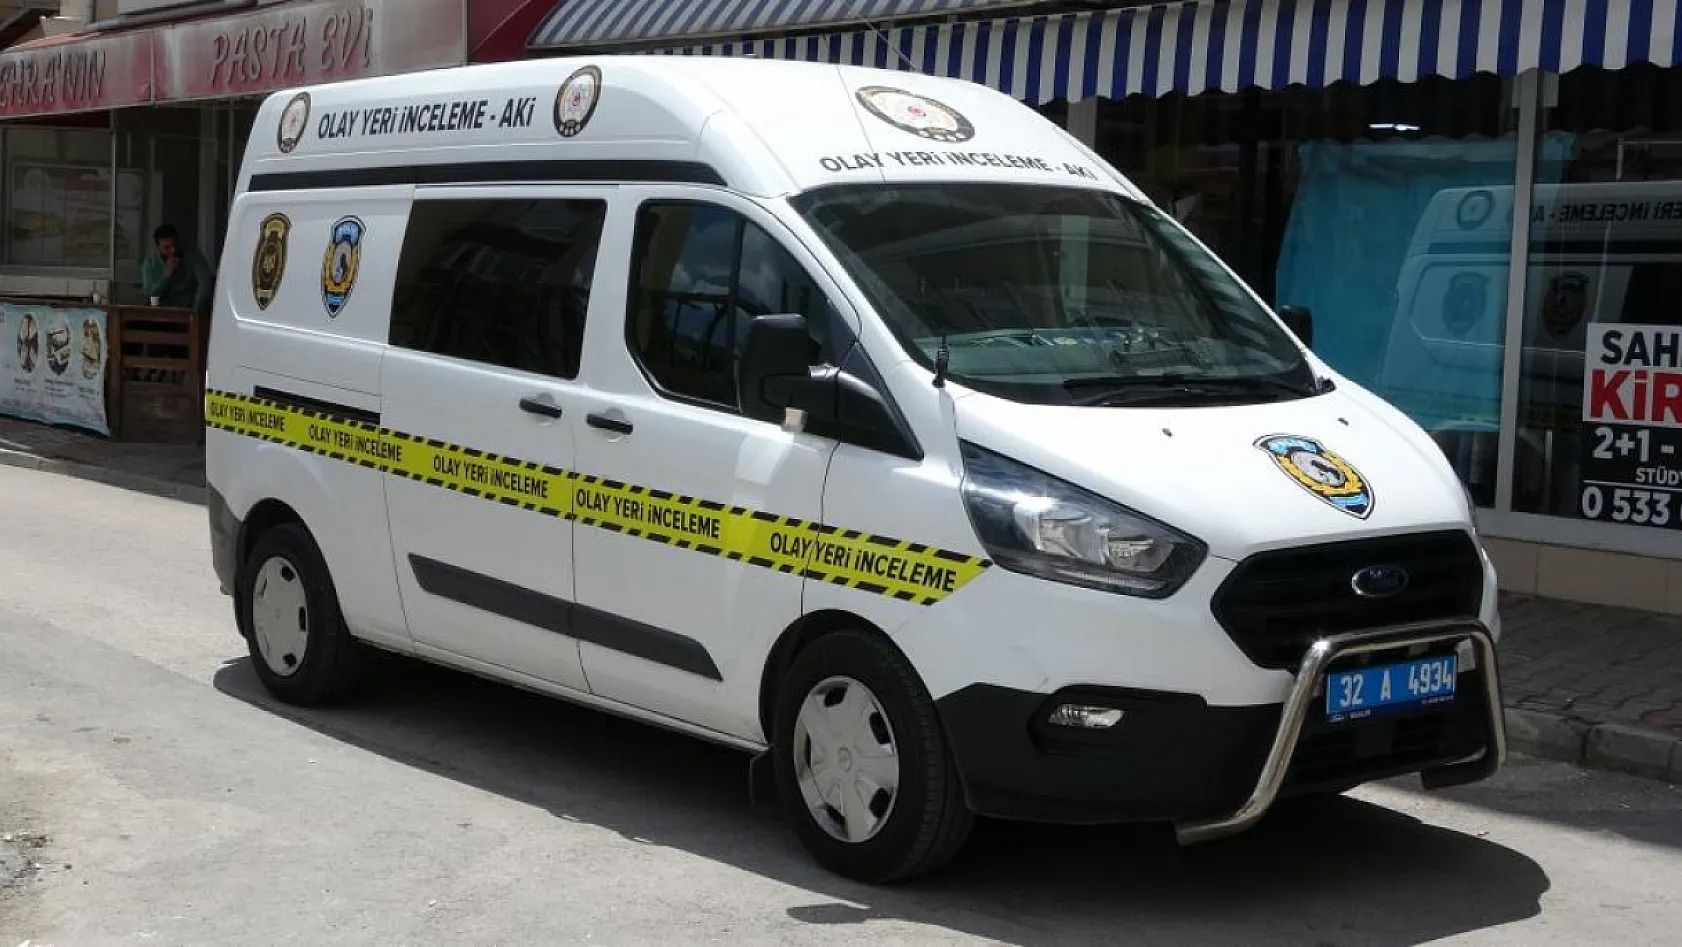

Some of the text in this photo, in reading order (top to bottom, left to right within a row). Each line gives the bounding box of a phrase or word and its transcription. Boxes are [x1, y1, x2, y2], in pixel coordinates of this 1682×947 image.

[212, 16, 306, 87] PASTA
[318, 107, 359, 139] OLAY
[819, 151, 884, 172] OLAY
[1601, 329, 1682, 367] SAH
[210, 402, 229, 419] OLAY
[308, 423, 331, 444] OLAY
[1592, 426, 1650, 462] 2+1
[433, 454, 460, 477] OLAY
[1635, 466, 1682, 486] STÜD
[576, 488, 611, 513] OLAY
[1582, 485, 1671, 526] 0 533
[770, 532, 812, 559] OLAY
[1340, 660, 1453, 708] 32 A 4934
